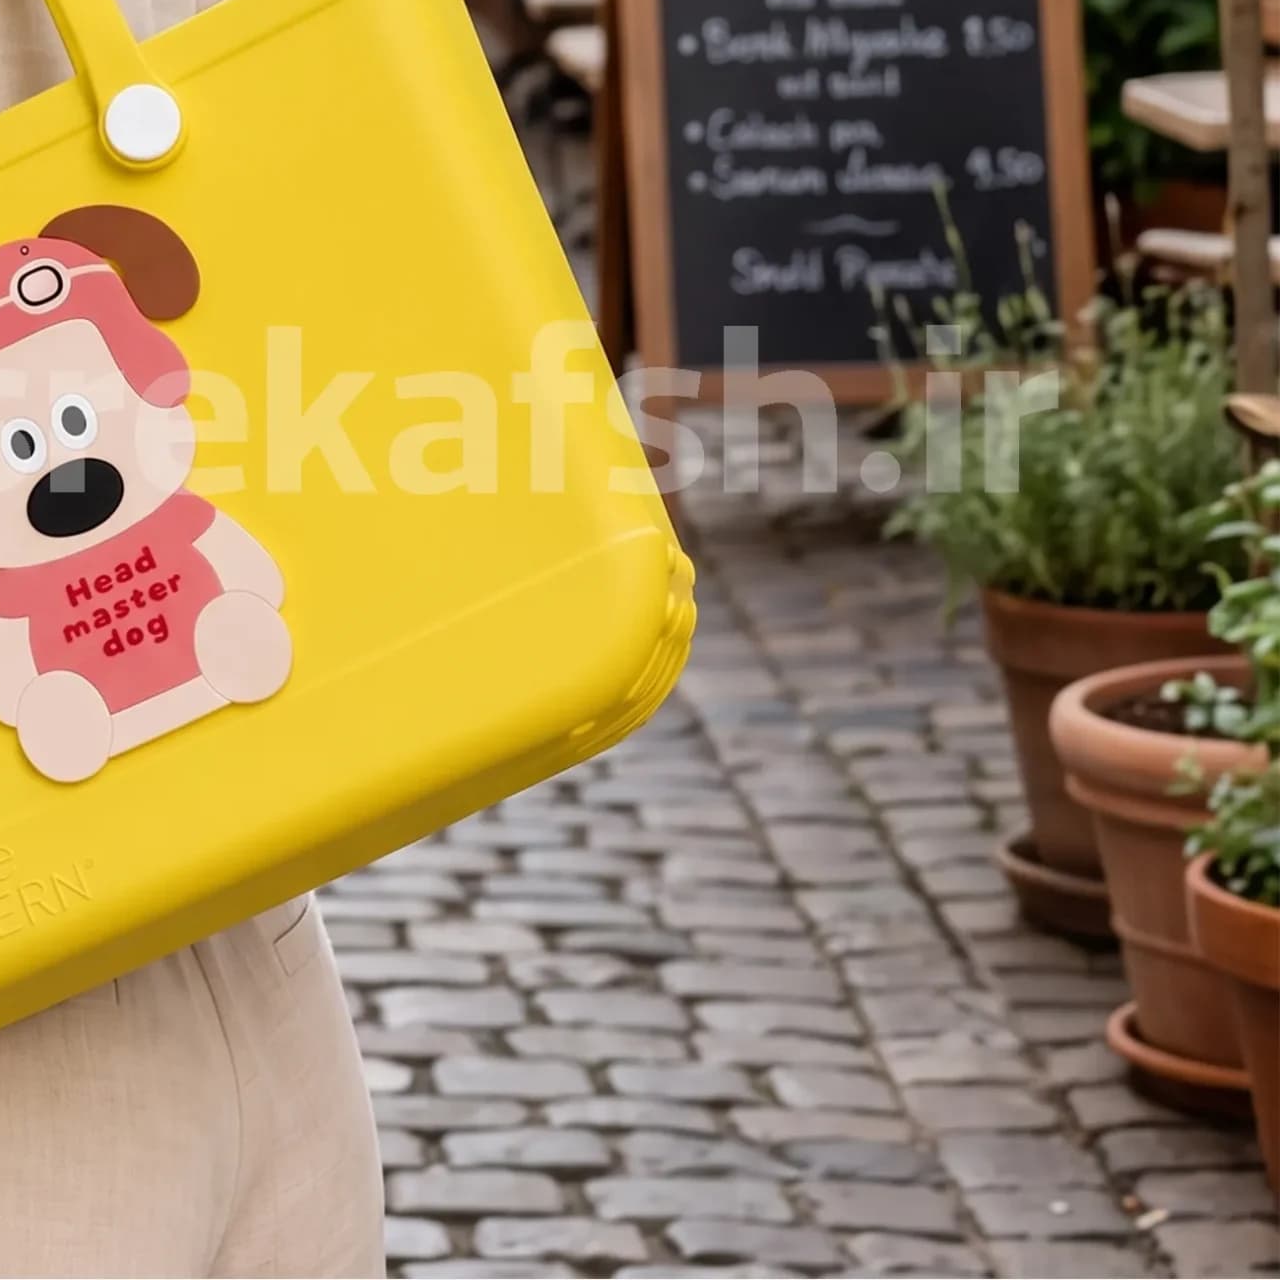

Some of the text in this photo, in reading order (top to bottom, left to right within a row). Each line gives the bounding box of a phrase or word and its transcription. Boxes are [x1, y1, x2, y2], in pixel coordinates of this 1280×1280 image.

[66, 546, 157, 607] Head
[63, 574, 181, 643] master
[103, 613, 169, 657] dog
